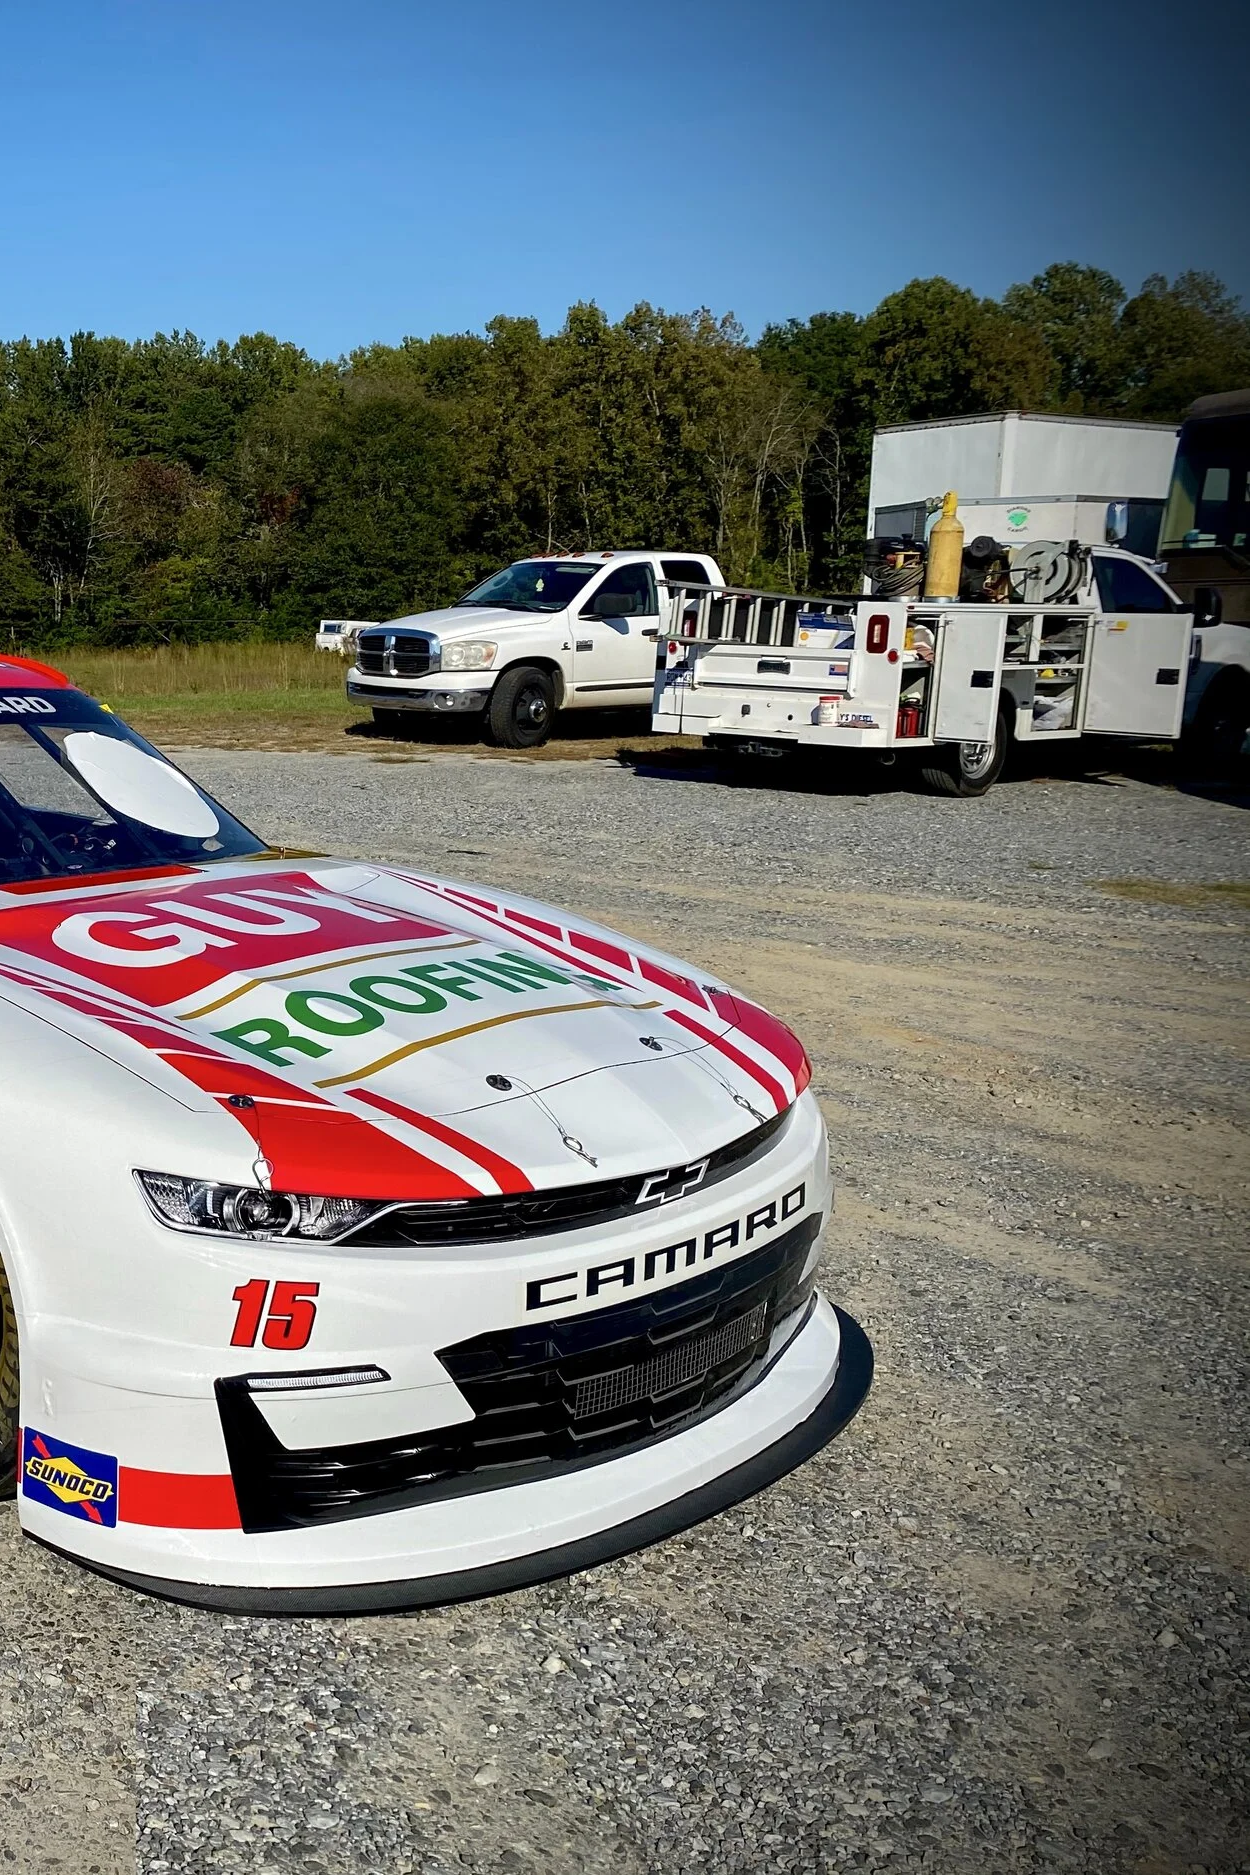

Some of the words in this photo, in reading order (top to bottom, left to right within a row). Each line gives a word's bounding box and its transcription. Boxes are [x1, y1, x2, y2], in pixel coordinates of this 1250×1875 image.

[52, 886, 401, 967] GUY
[526, 1181, 806, 1311] CAMARO
[230, 1279, 320, 1350] 15
[28, 1460, 110, 1500] SUNOCO
